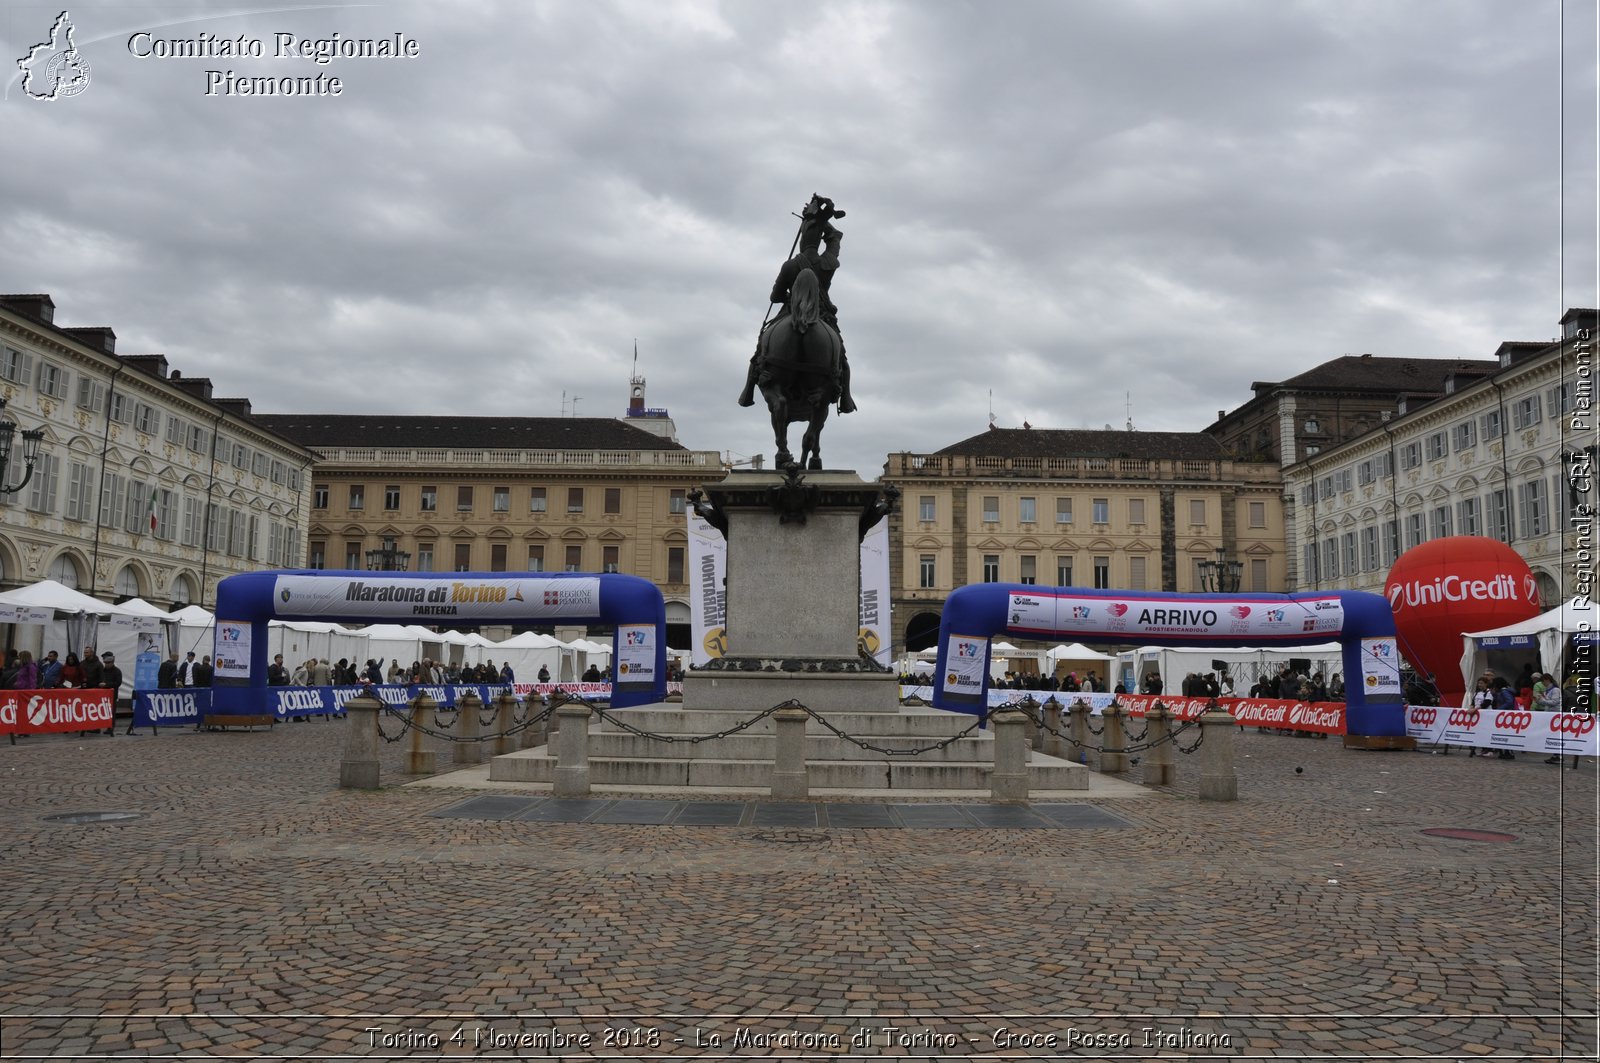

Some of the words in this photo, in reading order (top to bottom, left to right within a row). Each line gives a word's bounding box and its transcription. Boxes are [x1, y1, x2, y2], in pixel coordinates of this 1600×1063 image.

[346, 582, 426, 602] Maratona
[427, 586, 448, 603] di
[452, 582, 508, 604] Torino
[560, 590, 592, 598] REGIONE
[1405, 574, 1518, 606] UniCredit
[412, 605, 457, 616] PARTENZA
[1138, 609, 1218, 626] ARRIVO
[49, 697, 113, 724] UniCredit
[1245, 703, 1287, 722] UniCredit
[1301, 706, 1342, 727] UniCredit
[1411, 708, 1437, 728] coop
[1448, 709, 1480, 731] coop
[1495, 711, 1532, 734] coop
[1549, 713, 1596, 738] coop
